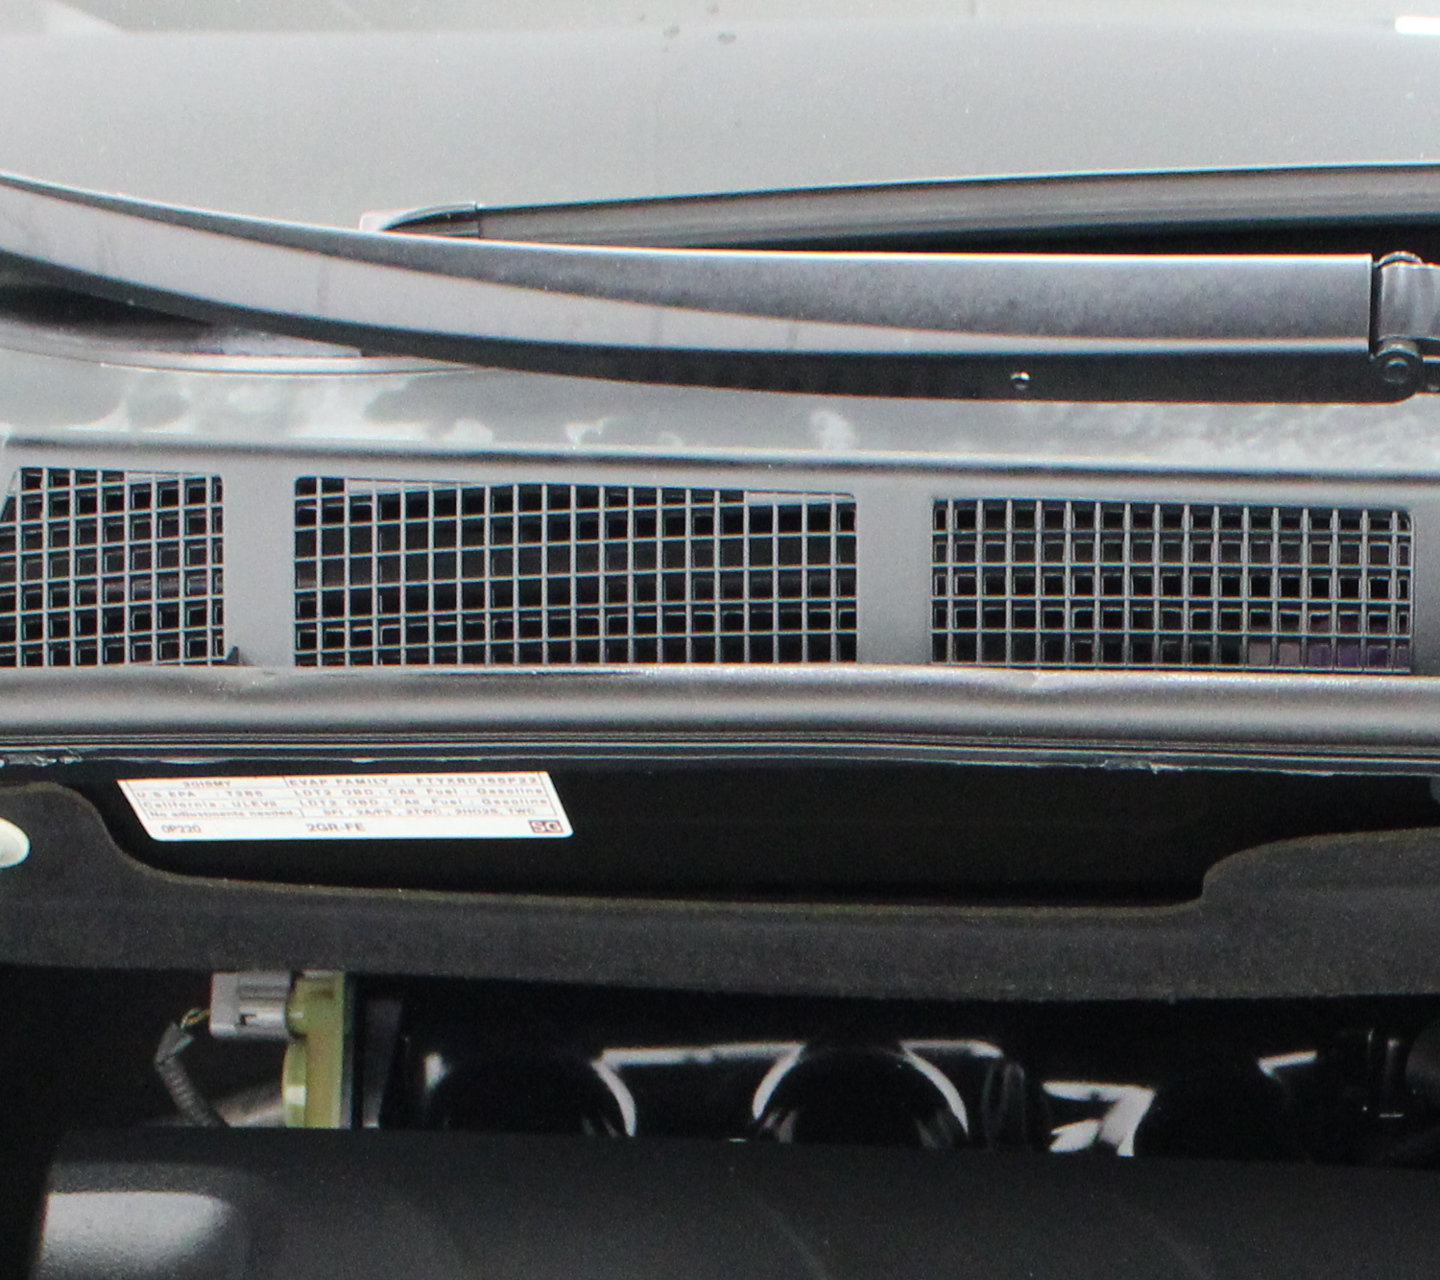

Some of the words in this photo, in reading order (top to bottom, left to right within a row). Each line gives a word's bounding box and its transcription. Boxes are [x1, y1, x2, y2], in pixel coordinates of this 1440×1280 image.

[335, 778, 389, 787] FAMILY
[477, 786, 544, 795] Gasoline
[481, 798, 548, 806] Gasoline
[306, 822, 366, 833] 2GR-FE
